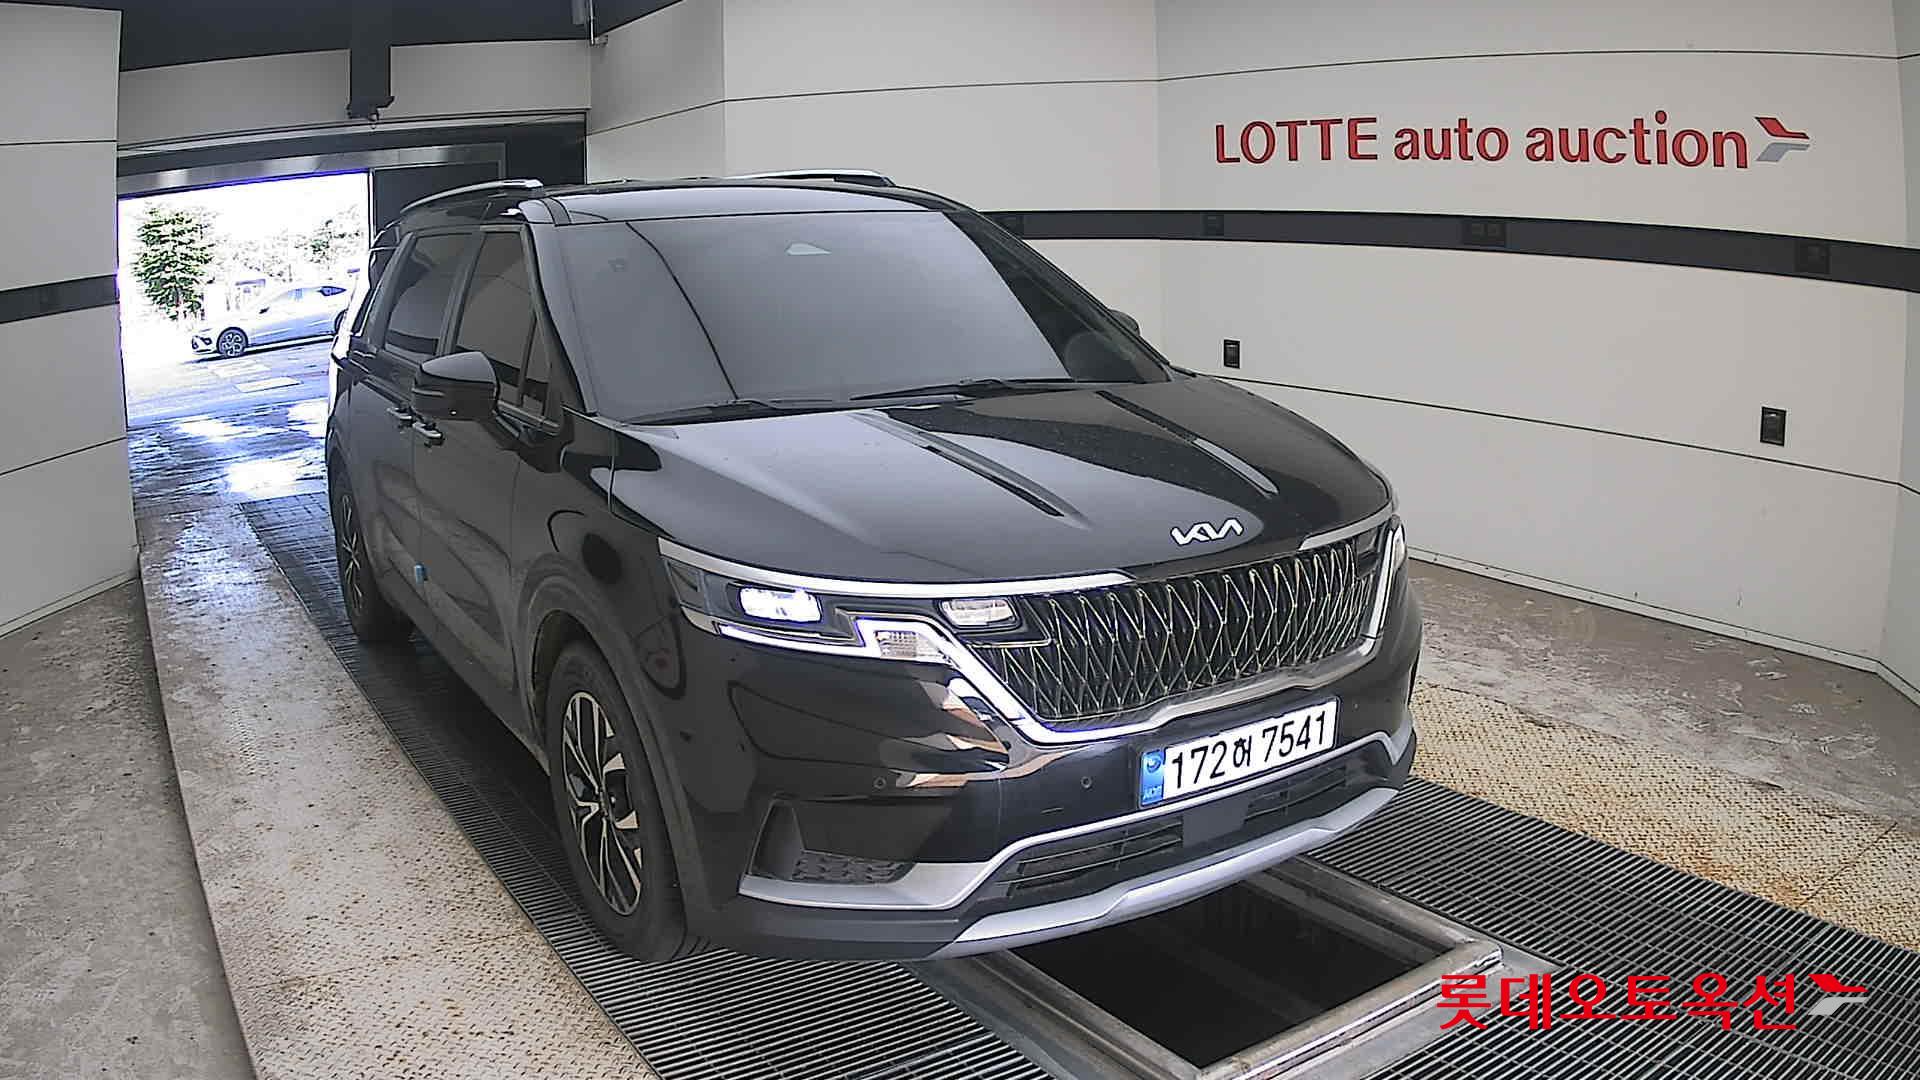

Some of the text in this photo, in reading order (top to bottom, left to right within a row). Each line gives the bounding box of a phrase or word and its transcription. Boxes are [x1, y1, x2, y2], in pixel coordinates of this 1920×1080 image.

[1214, 110, 1750, 169] LOTTE auto auction
[1262, 710, 1327, 762] 7541
